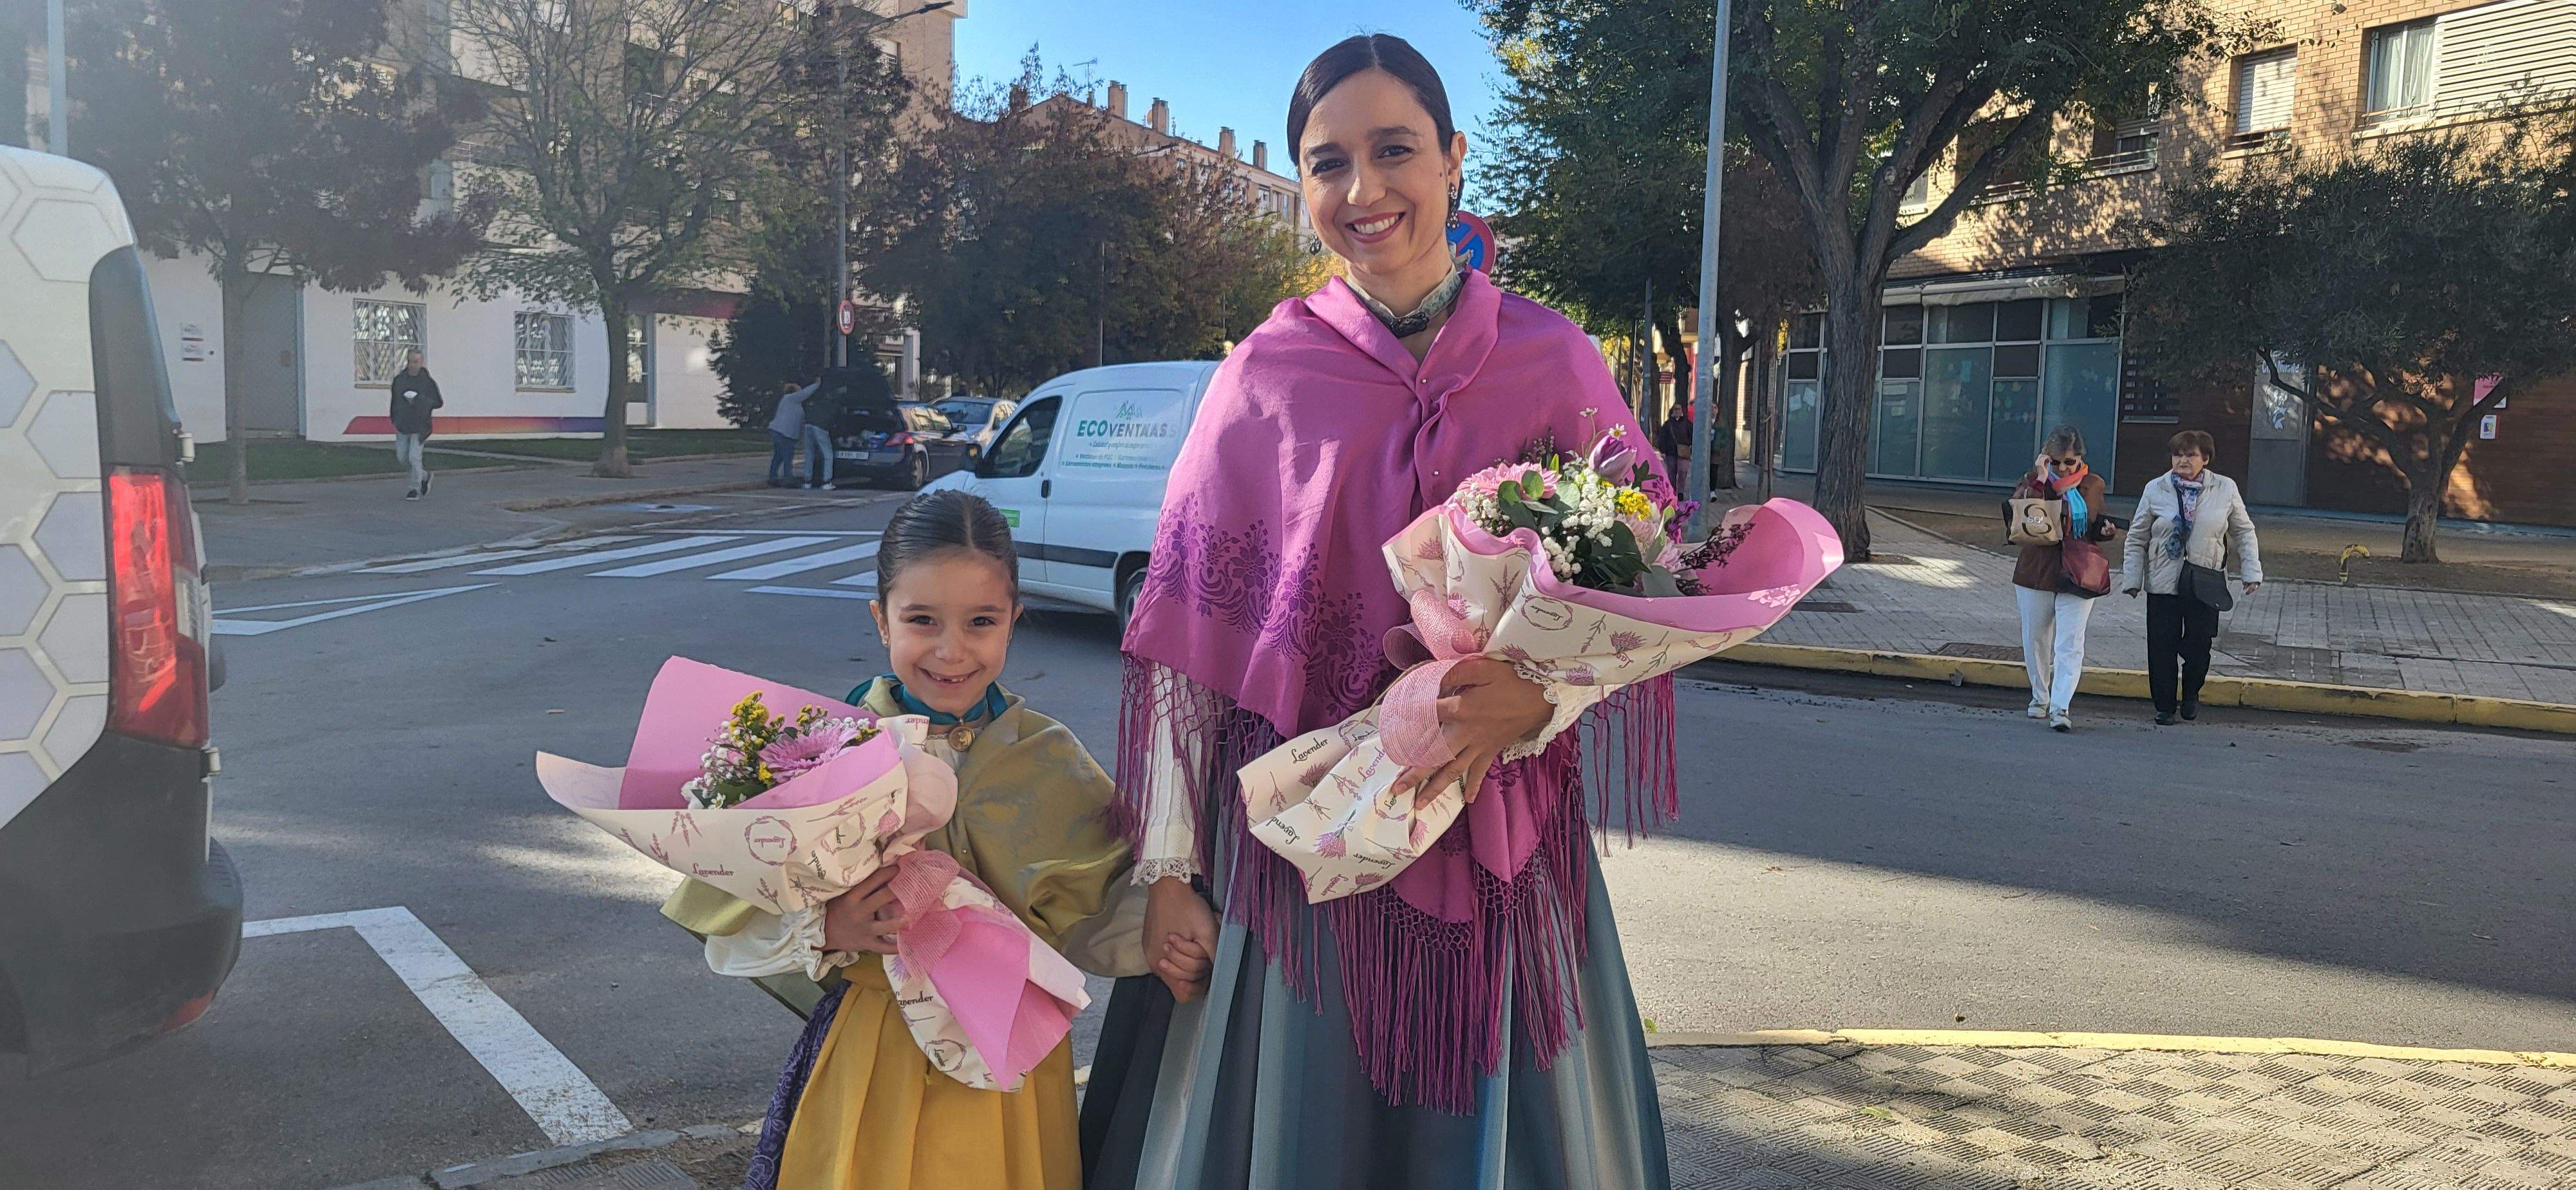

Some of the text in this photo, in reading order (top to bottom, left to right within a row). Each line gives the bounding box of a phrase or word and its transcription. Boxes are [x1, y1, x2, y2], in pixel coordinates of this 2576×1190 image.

[905, 717, 929, 731] ender
[1291, 737, 1329, 764] Lavender
[1358, 746, 1385, 782] Lavend
[1266, 817, 1300, 845] Lavend
[693, 862, 734, 877] Lavender
[1353, 853, 1396, 870] Lavender
